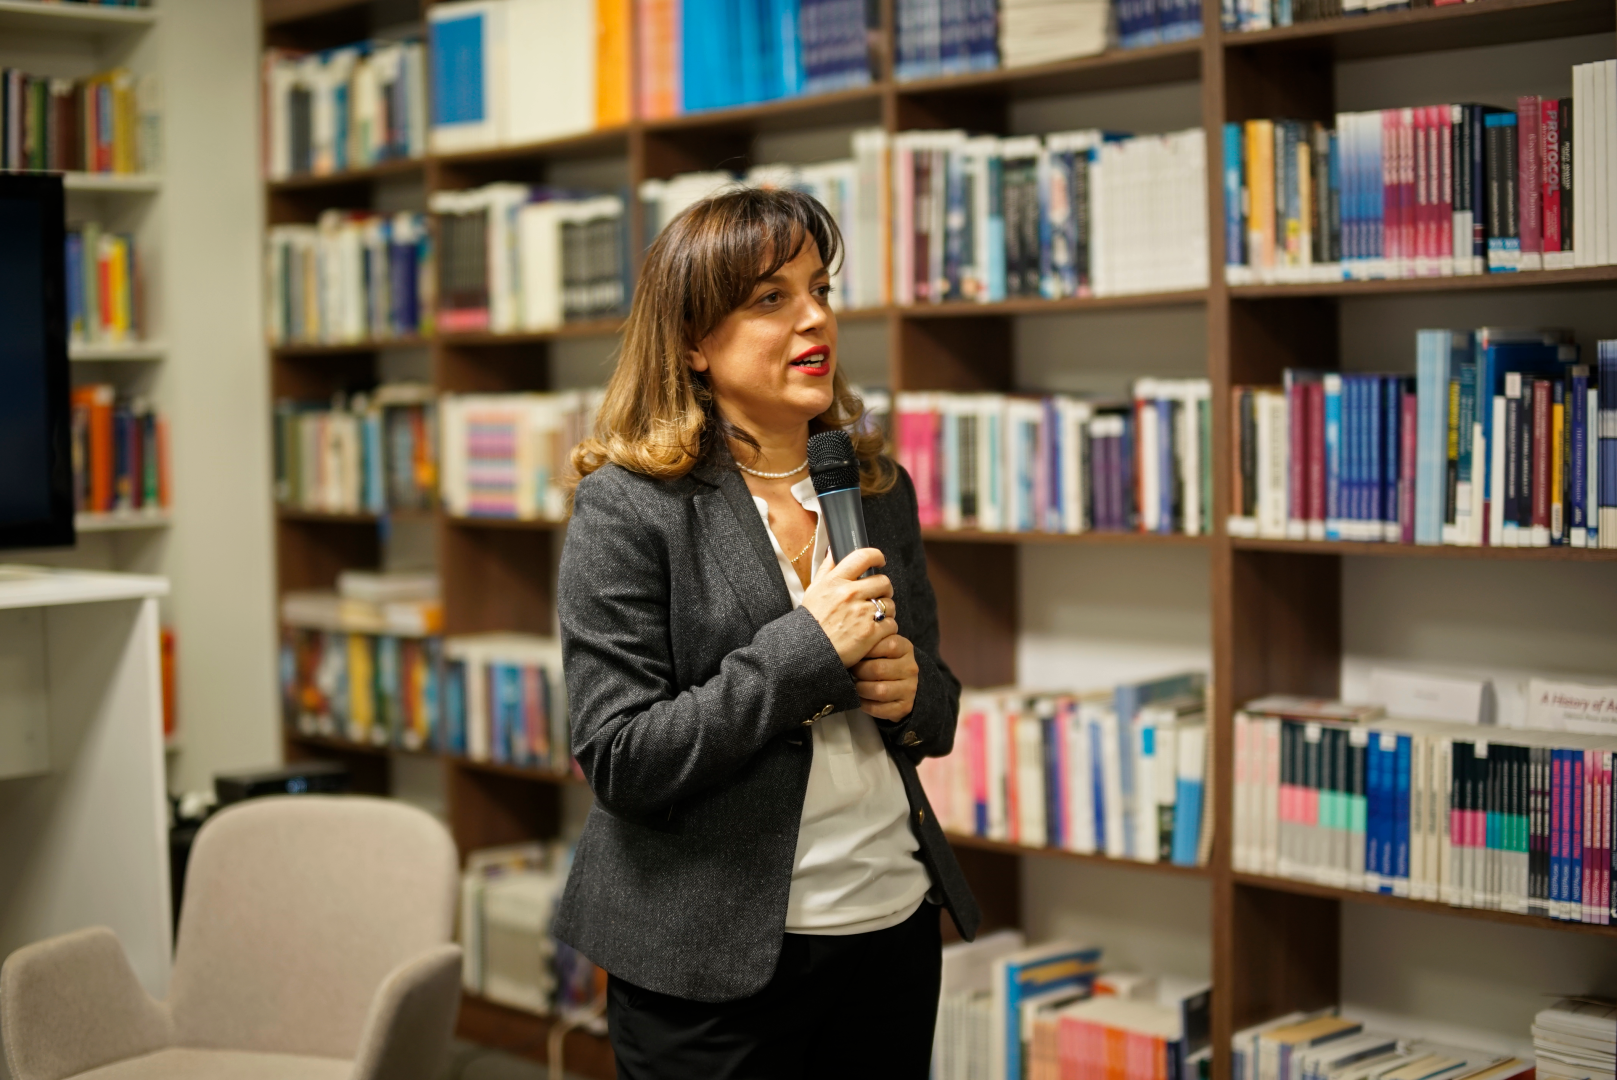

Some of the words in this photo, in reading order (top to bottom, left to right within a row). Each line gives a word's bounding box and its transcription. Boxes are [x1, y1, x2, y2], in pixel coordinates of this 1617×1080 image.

[1546, 109, 1560, 196] PROTOCOL
[1540, 691, 1549, 705] A
[1551, 691, 1590, 713] History
[1592, 696, 1607, 713] of
[1607, 698, 1617, 714] A
